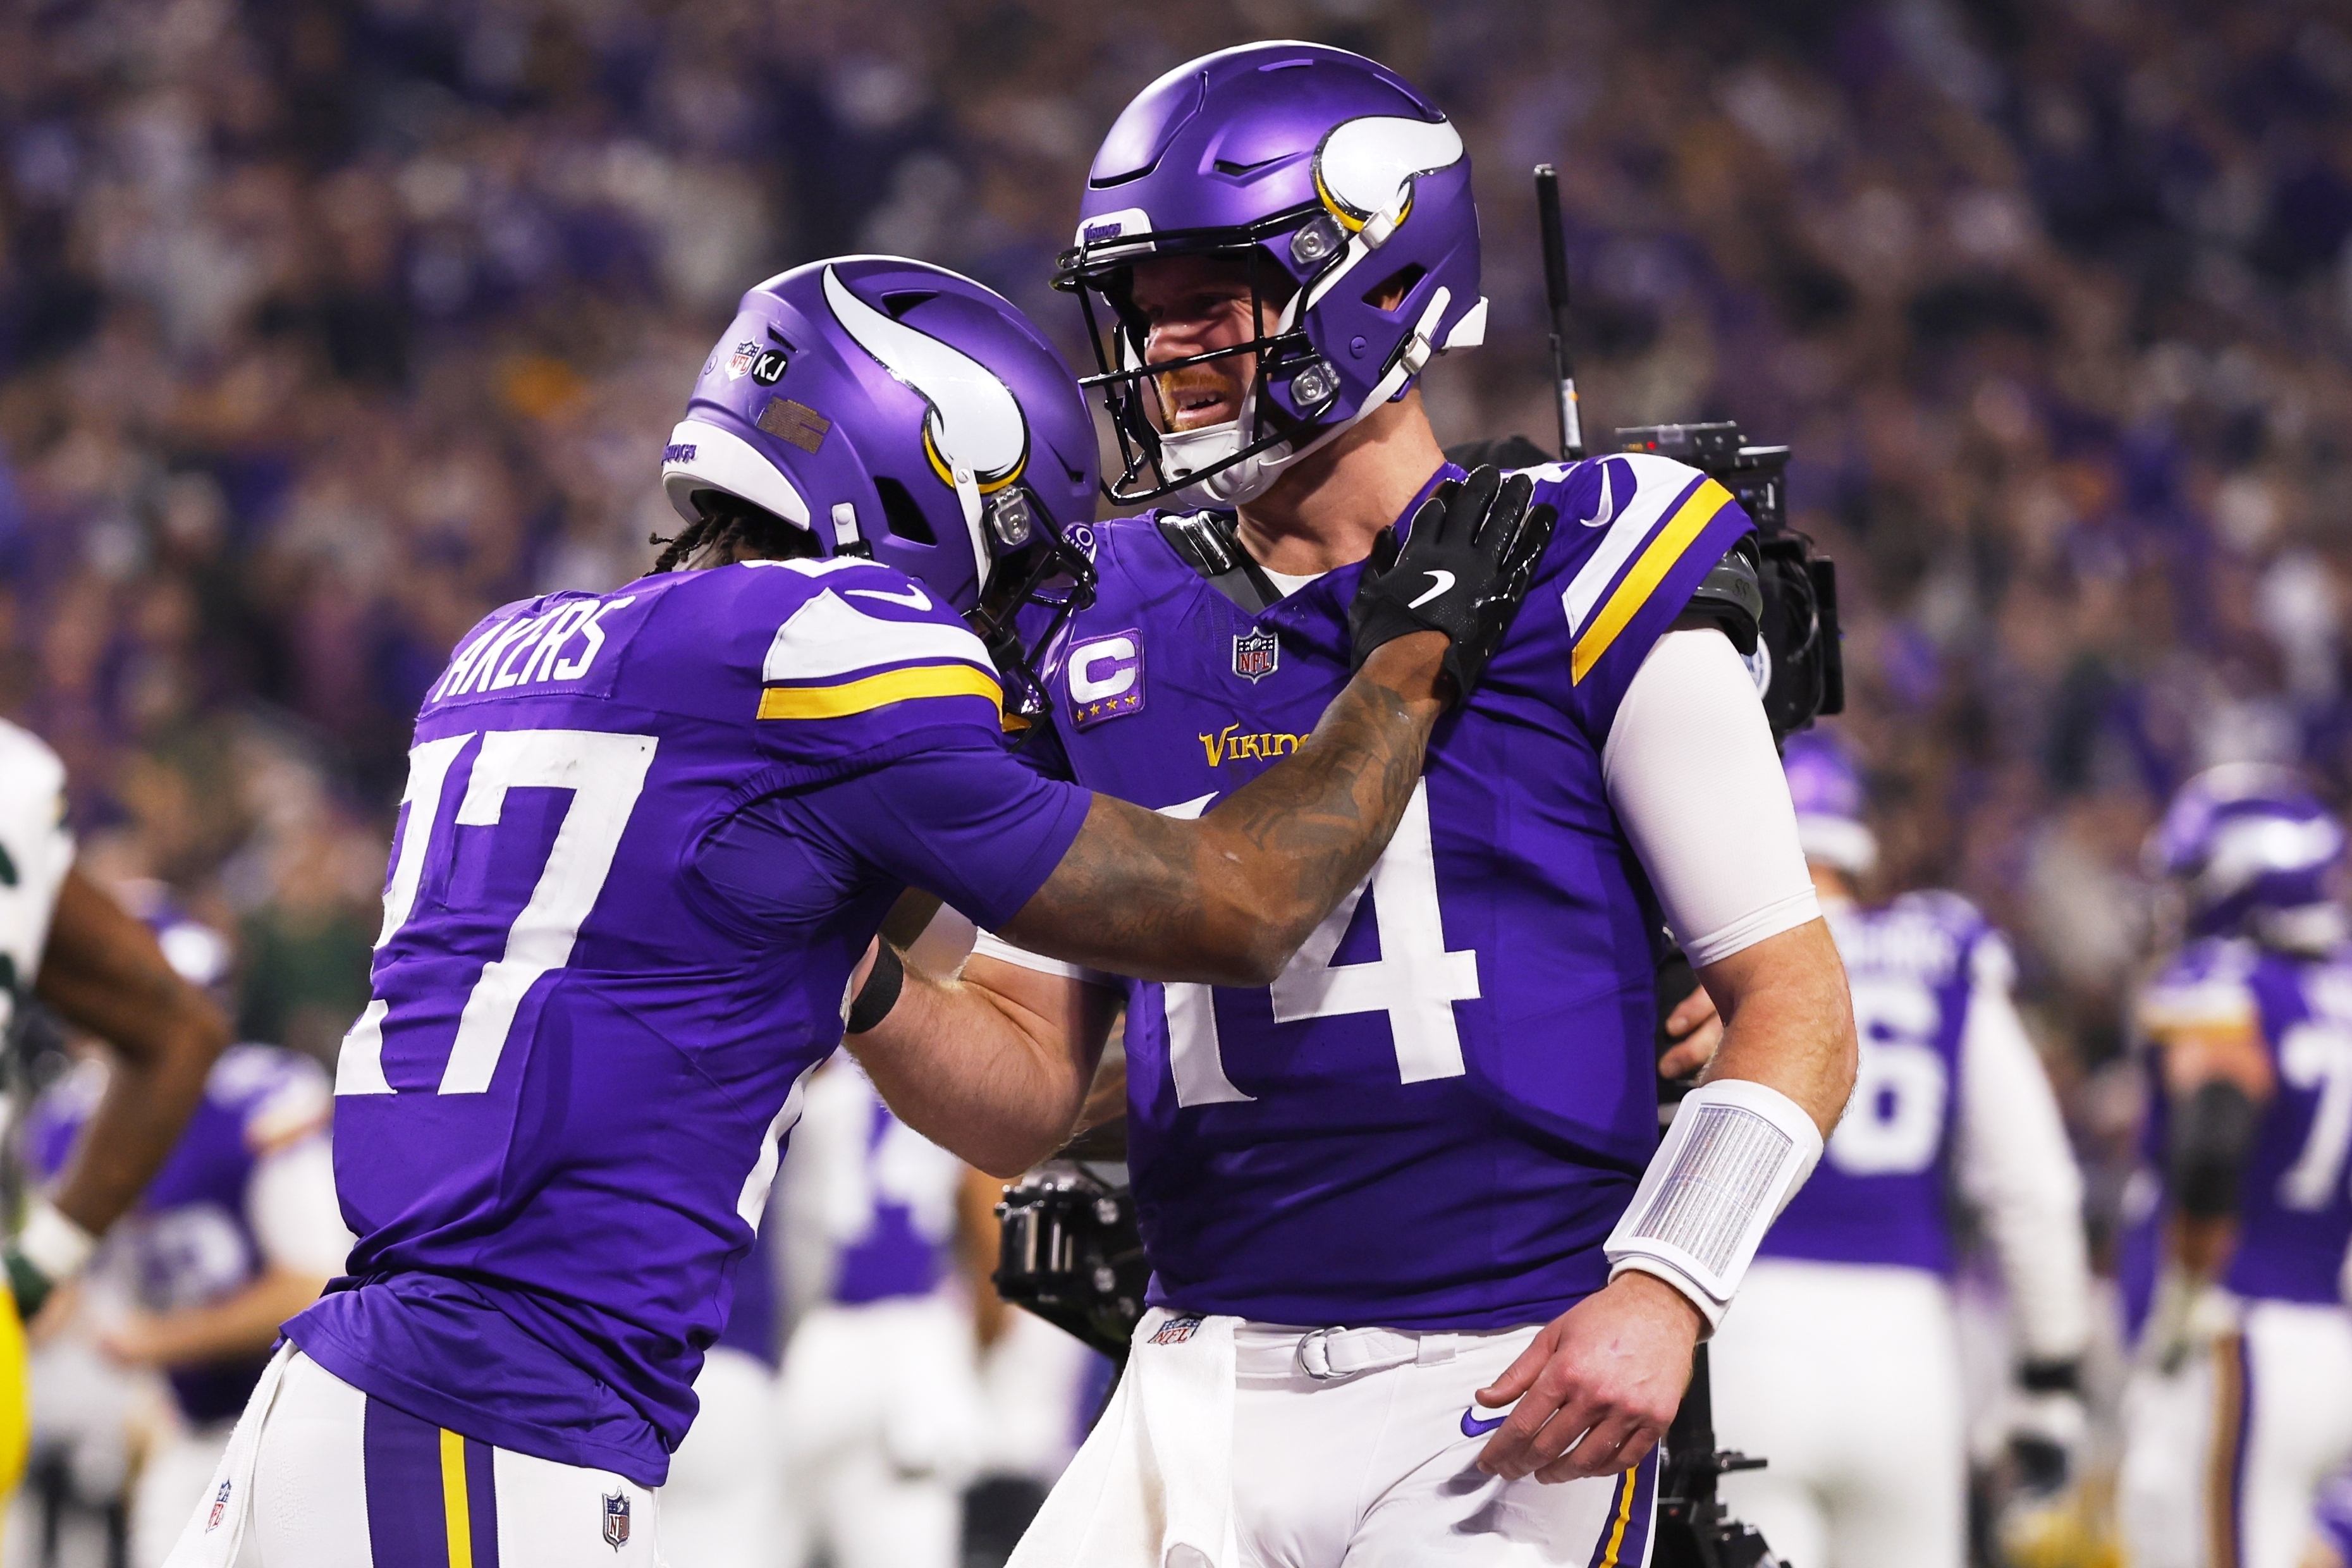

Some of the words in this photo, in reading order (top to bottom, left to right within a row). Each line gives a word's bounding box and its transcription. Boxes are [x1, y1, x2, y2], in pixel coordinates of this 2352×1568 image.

[753, 353, 786, 382] KJ
[431, 595, 637, 704] AKERS
[1068, 637, 1137, 704] C
[1240, 652, 1271, 673] NFL
[1198, 719, 1311, 767] VIKIN
[1151, 775, 1485, 1108] 14
[1153, 1328, 1188, 1344] NFL
